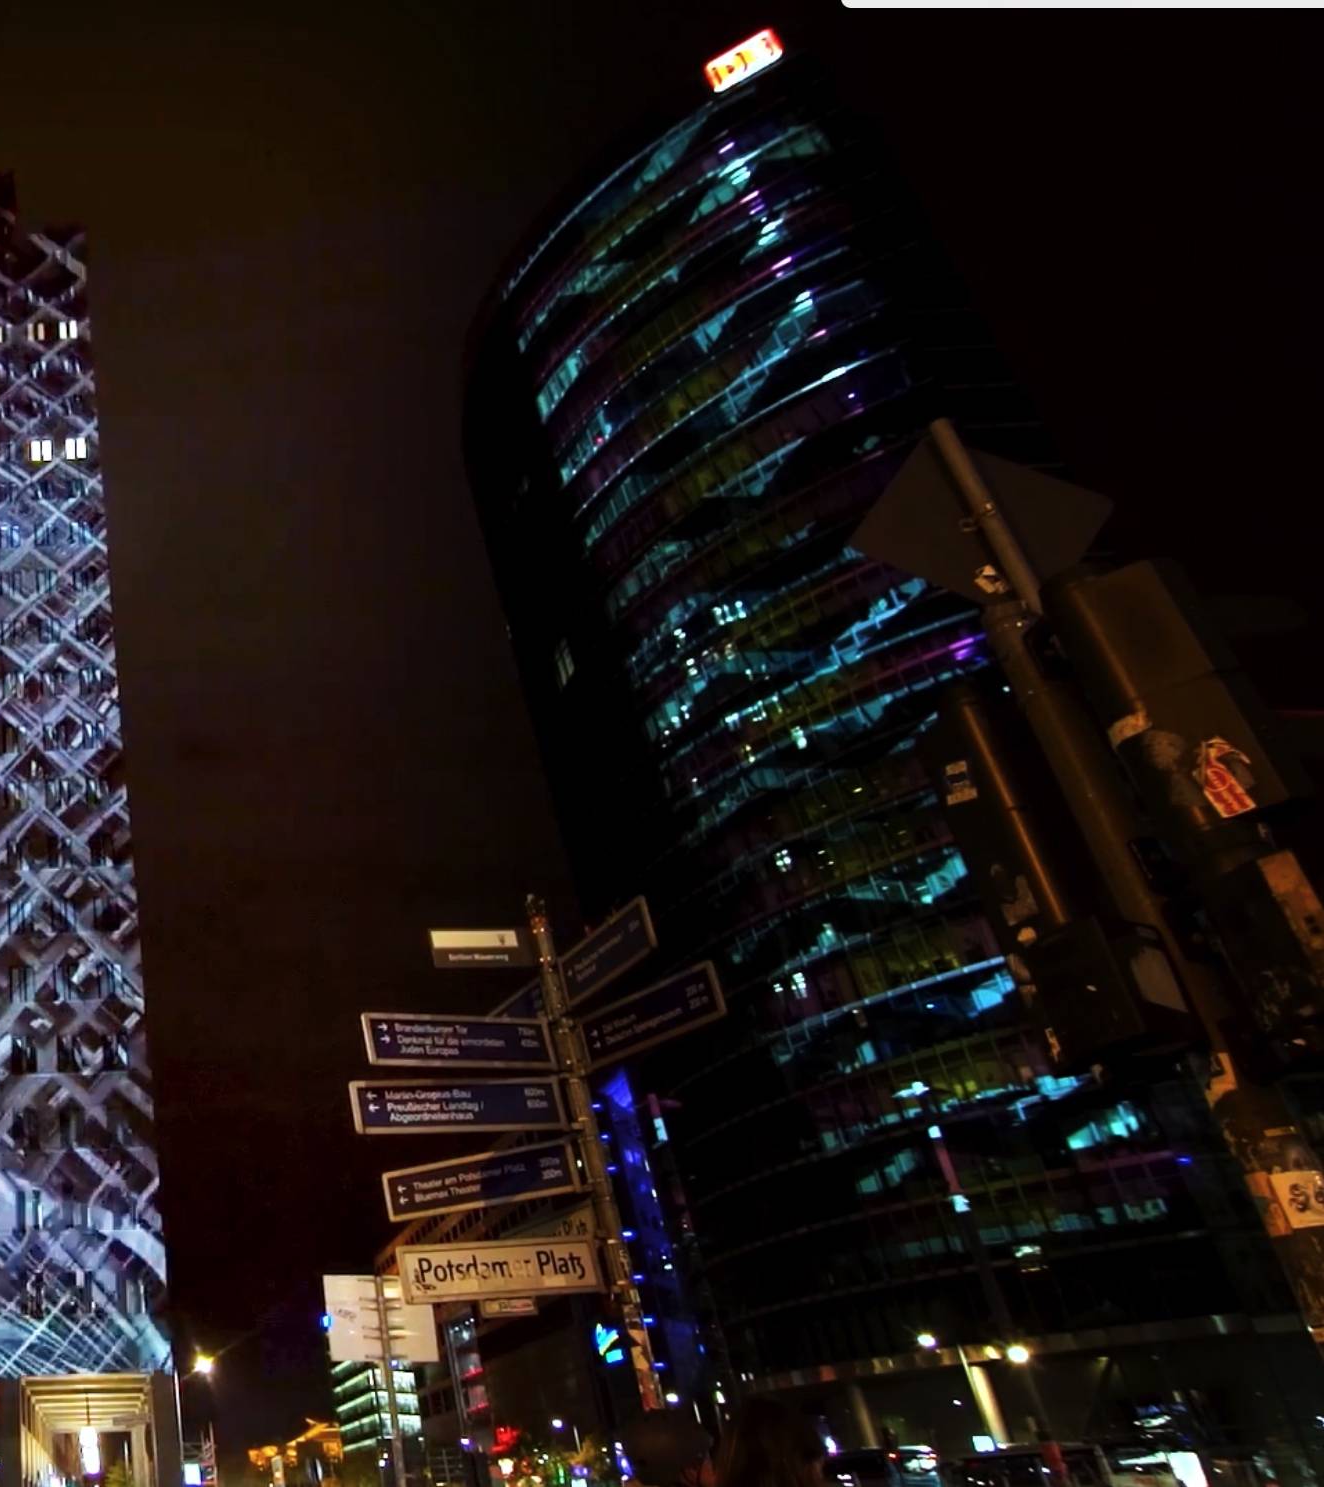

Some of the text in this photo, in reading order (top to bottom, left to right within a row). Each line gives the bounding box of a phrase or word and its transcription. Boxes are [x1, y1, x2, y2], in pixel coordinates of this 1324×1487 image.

[394, 1022, 454, 1036] Brandenburger
[454, 1025, 468, 1034] Tor
[396, 1034, 433, 1045] Denkmal
[461, 1037, 506, 1047] ermordeten
[399, 1045, 460, 1056] Juden Europas
[387, 1101, 441, 1112] Preußischer
[442, 1100, 479, 1112] Landtag
[390, 1112, 475, 1123] Abgeordnetenhaus
[413, 1178, 443, 1190] Theater
[444, 1176, 457, 1186] am
[458, 1167, 502, 1183] Potsdamer
[449, 1183, 481, 1196] Theater
[417, 1249, 586, 1282] Potsdamer Platz
